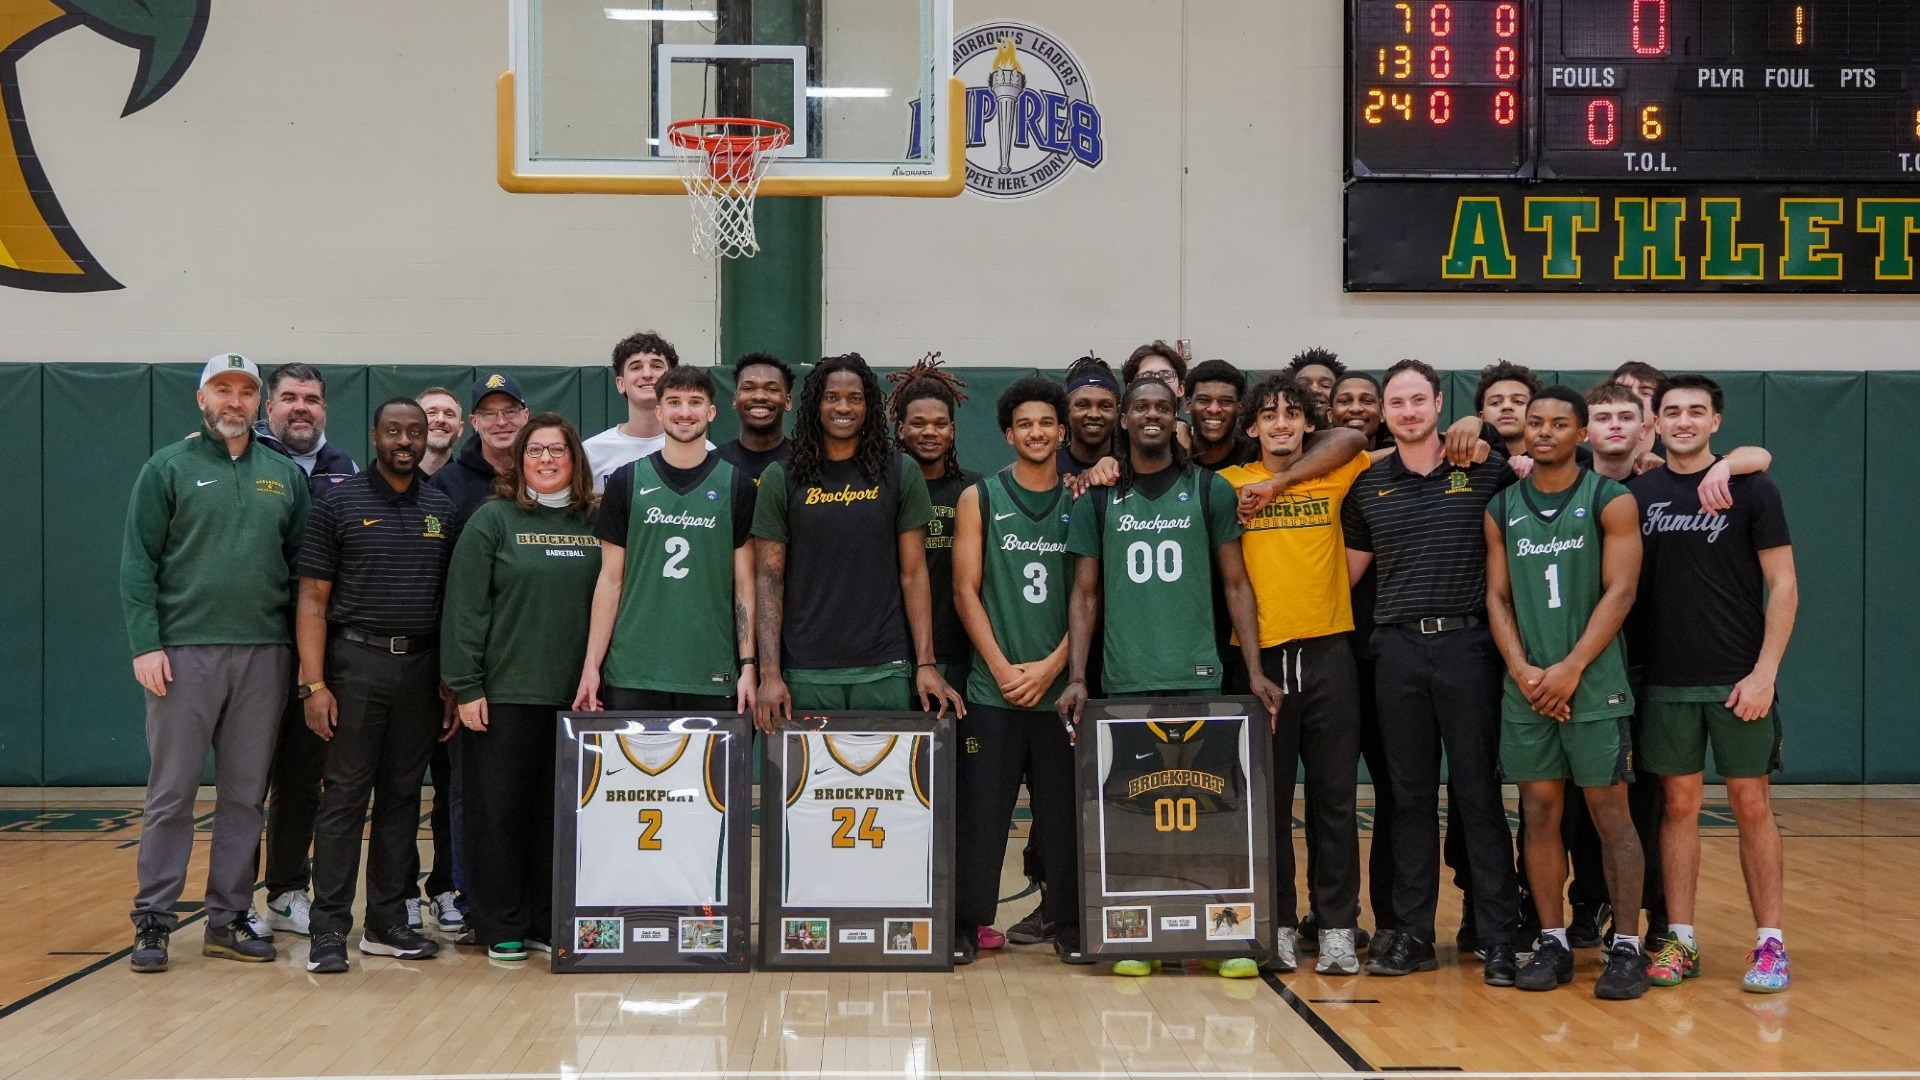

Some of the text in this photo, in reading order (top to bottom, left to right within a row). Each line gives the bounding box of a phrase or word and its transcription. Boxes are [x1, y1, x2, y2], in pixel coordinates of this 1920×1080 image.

[1395, 3, 1515, 37] 7 0 0
[1632, 0, 1666, 54] 0
[1796, 6, 1803, 45] 1
[953, 30, 1078, 86] MORROW'S LEADERS
[1379, 46, 1515, 79] 13 0 0
[1552, 67, 1615, 87] FOULS
[1698, 68, 1876, 88] PLYR FOUL PTS
[1365, 90, 1514, 124] 24 0 0
[1588, 100, 1662, 145] 0 6
[965, 153, 1067, 190] PETE HERE TODAY
[1623, 152, 1677, 172] T.O.L.
[1442, 197, 1920, 280] ATHLET
[228, 354, 244, 368] B
[805, 484, 879, 506] Brockport
[1255, 500, 1329, 518] ROCKPORT
[644, 507, 715, 529] Brockport
[1117, 514, 1191, 533] Brockport
[1642, 501, 1729, 543] Family
[545, 549, 585, 557] BASKETBALL
[662, 536, 690, 579] 2
[1001, 534, 1066, 555] Brockpor
[1517, 535, 1584, 556] Brockport
[1127, 540, 1182, 583] 00
[1023, 562, 1048, 604] 3
[1545, 564, 1561, 608] 1
[814, 788, 904, 801] BROCKPORT
[1129, 770, 1224, 798] BROCKPORT
[638, 809, 662, 850] 2
[832, 807, 885, 849] 24
[1155, 798, 1197, 831] 00
